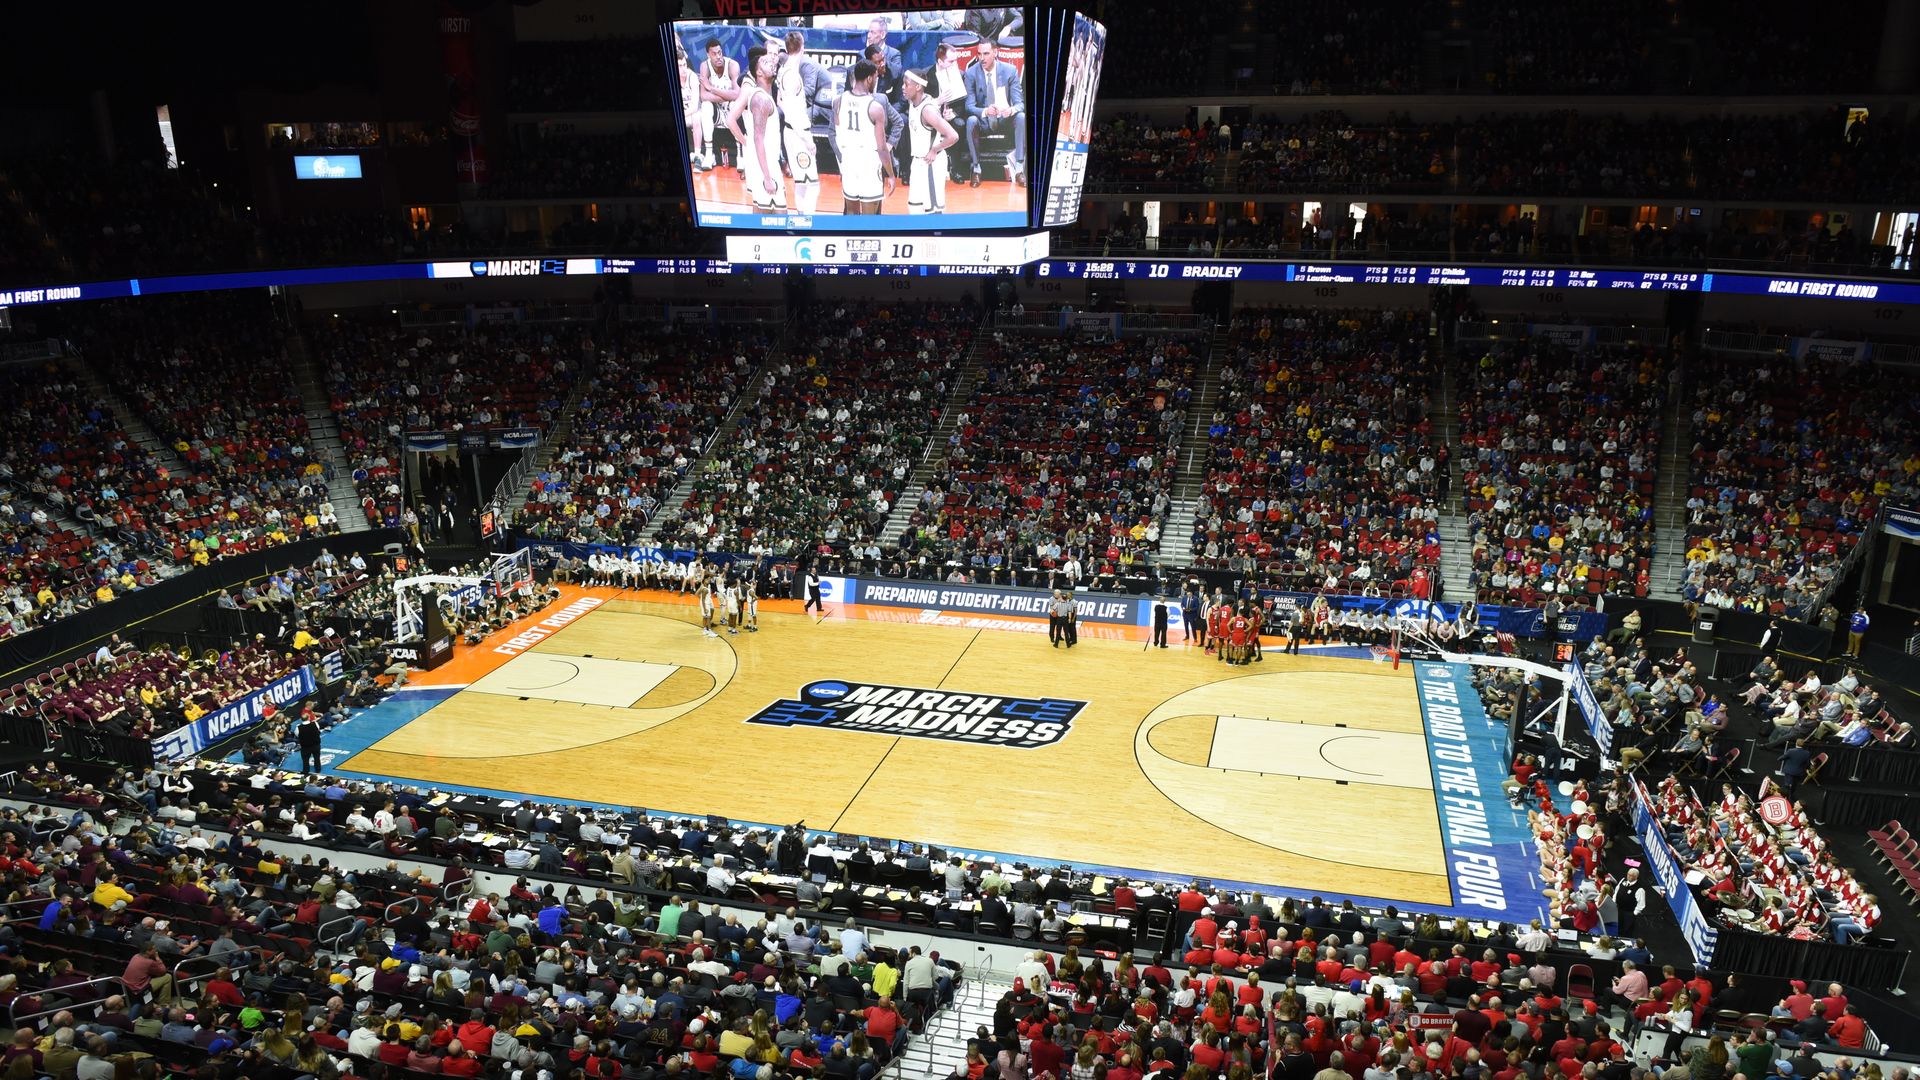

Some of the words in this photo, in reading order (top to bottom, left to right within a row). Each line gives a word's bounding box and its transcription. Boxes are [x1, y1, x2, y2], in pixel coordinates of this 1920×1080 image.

[847, 110, 860, 132] 11
[825, 243, 837, 258] 6
[891, 244, 914, 258] 10
[487, 259, 540, 277] MARCH
[1039, 263, 1051, 276] 6
[1149, 265, 1169, 278] 10
[1182, 266, 1242, 279] BRADLEY
[1643, 273, 1659, 281] PTS
[1040, 282, 1062, 292] 104
[1501, 278, 1517, 286] PTS
[1768, 280, 1798, 294] NCAA
[1800, 282, 1836, 297] FIRST
[1835, 283, 1879, 299] ROUND
[15, 289, 45, 303] FIRST
[46, 286, 81, 301] ROUND
[1313, 287, 1338, 297] 105
[864, 585, 937, 605] PREPARING
[1102, 602, 1128, 619] LIFE
[493, 626, 552, 656] FIRST
[540, 596, 604, 628] ROUND
[919, 614, 964, 626] DES
[965, 617, 1050, 633] MOINES
[1236, 620, 1244, 628] 23
[811, 687, 845, 696] NCAA
[842, 686, 1003, 716] MARCH
[1422, 680, 1459, 704] THE
[208, 701, 250, 740] NCAA
[252, 675, 302, 715] MRCH
[844, 705, 1065, 742] MADNESS
[1426, 703, 1468, 742] ROAD
[1434, 742, 1473, 763] TO
[1437, 764, 1480, 797] THE
[1444, 795, 1493, 848] FINAL
[1645, 822, 1679, 899] MADNESS
[1453, 849, 1508, 911] FOUR
[650, 1027, 668, 1041] 24
